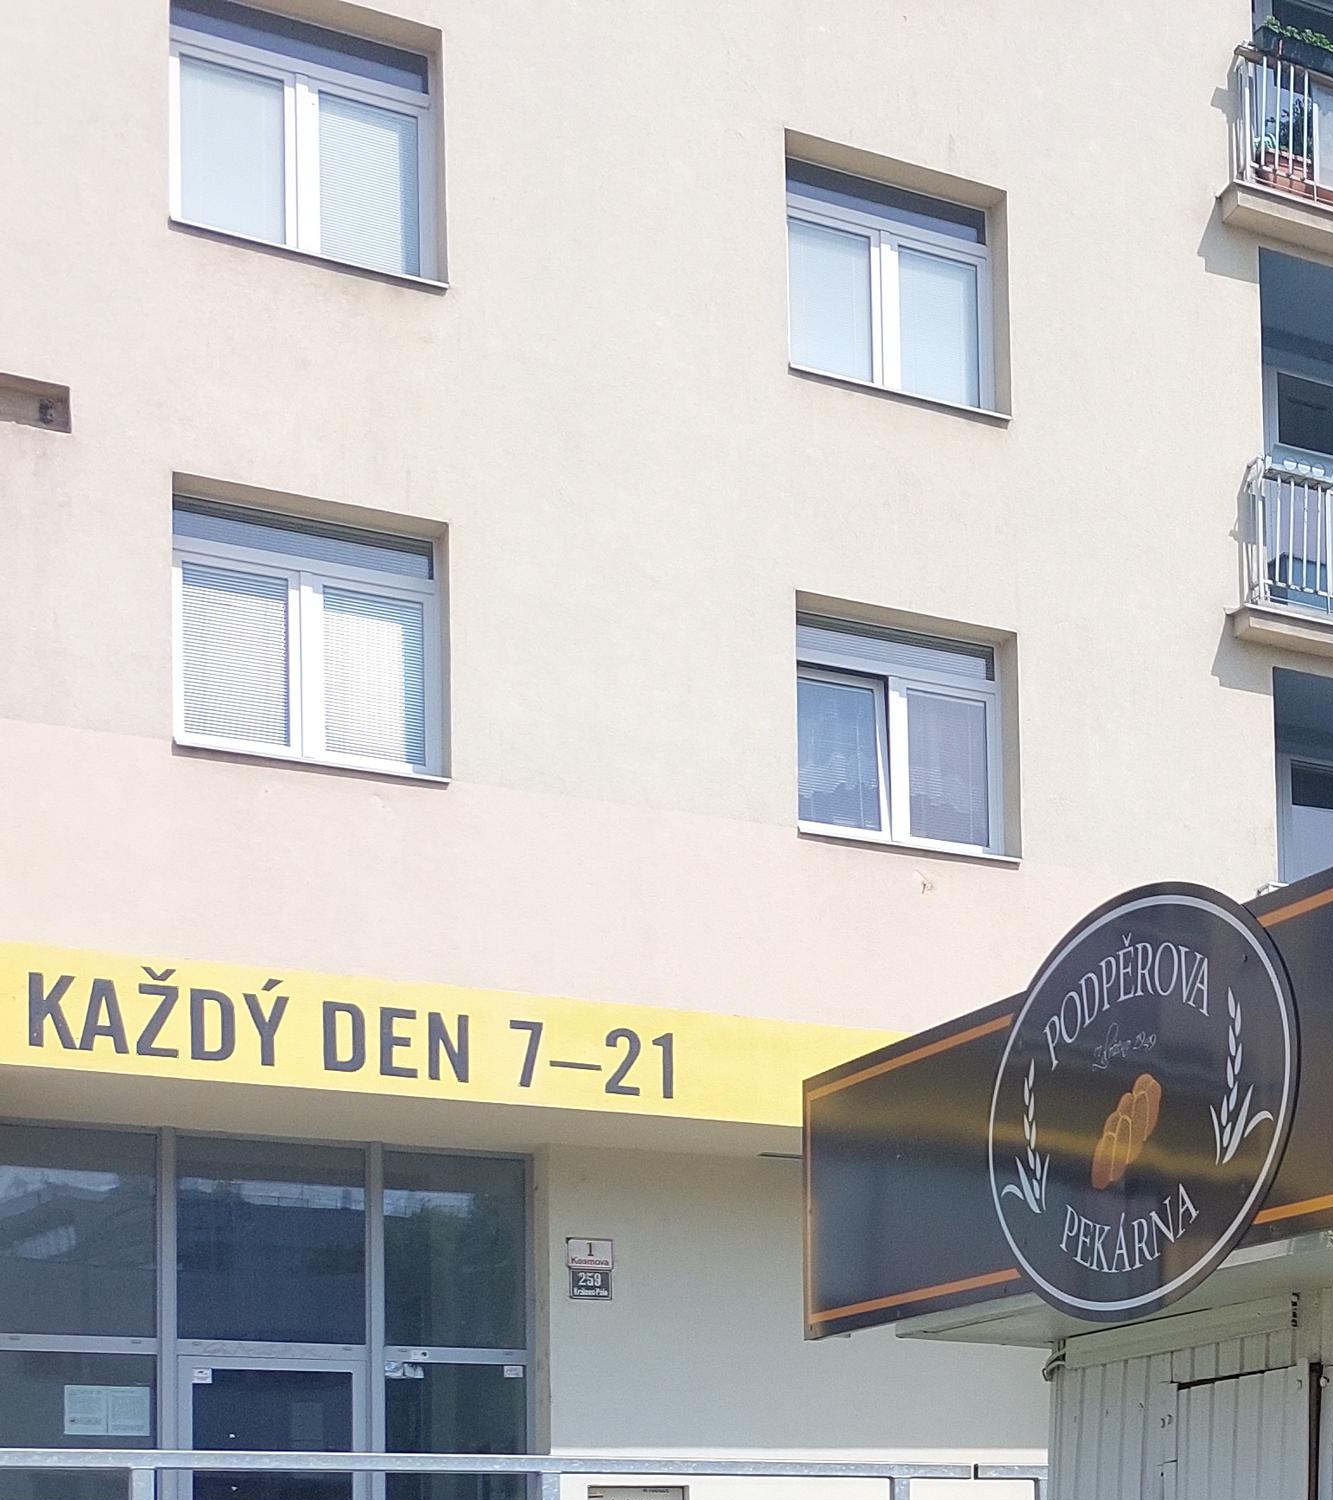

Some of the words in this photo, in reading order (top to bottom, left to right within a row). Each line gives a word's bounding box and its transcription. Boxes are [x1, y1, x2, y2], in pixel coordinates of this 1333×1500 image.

[27, 966, 290, 1067] KAŽDÝ
[321, 1000, 470, 1084] DEN
[1042, 931, 1210, 1072] PODPĚROVA
[586, 1242, 594, 1257] 1
[1060, 1182, 1200, 1274] PEKÁRNA
[578, 1272, 602, 1287] 259
